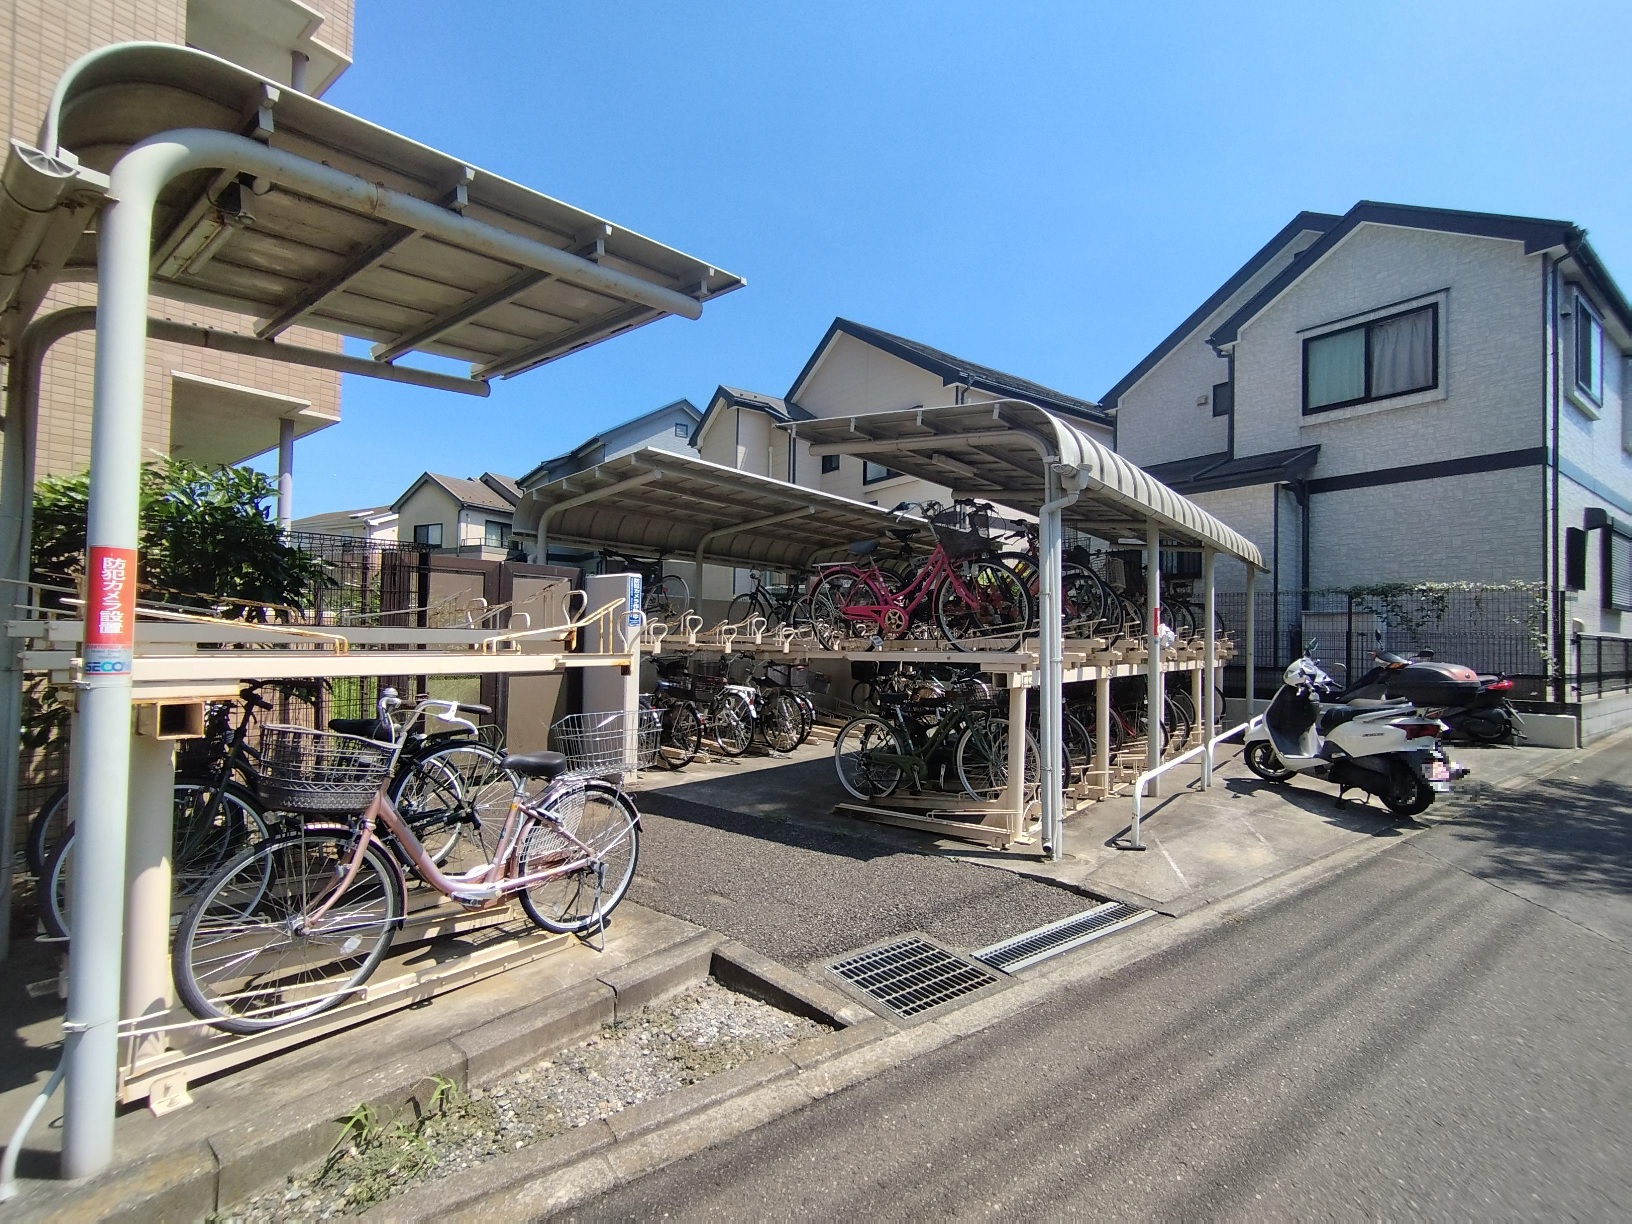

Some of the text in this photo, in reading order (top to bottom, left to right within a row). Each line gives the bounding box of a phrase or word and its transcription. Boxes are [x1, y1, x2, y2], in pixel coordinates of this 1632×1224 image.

[99, 557, 126, 634] 防犯カメラ設置
